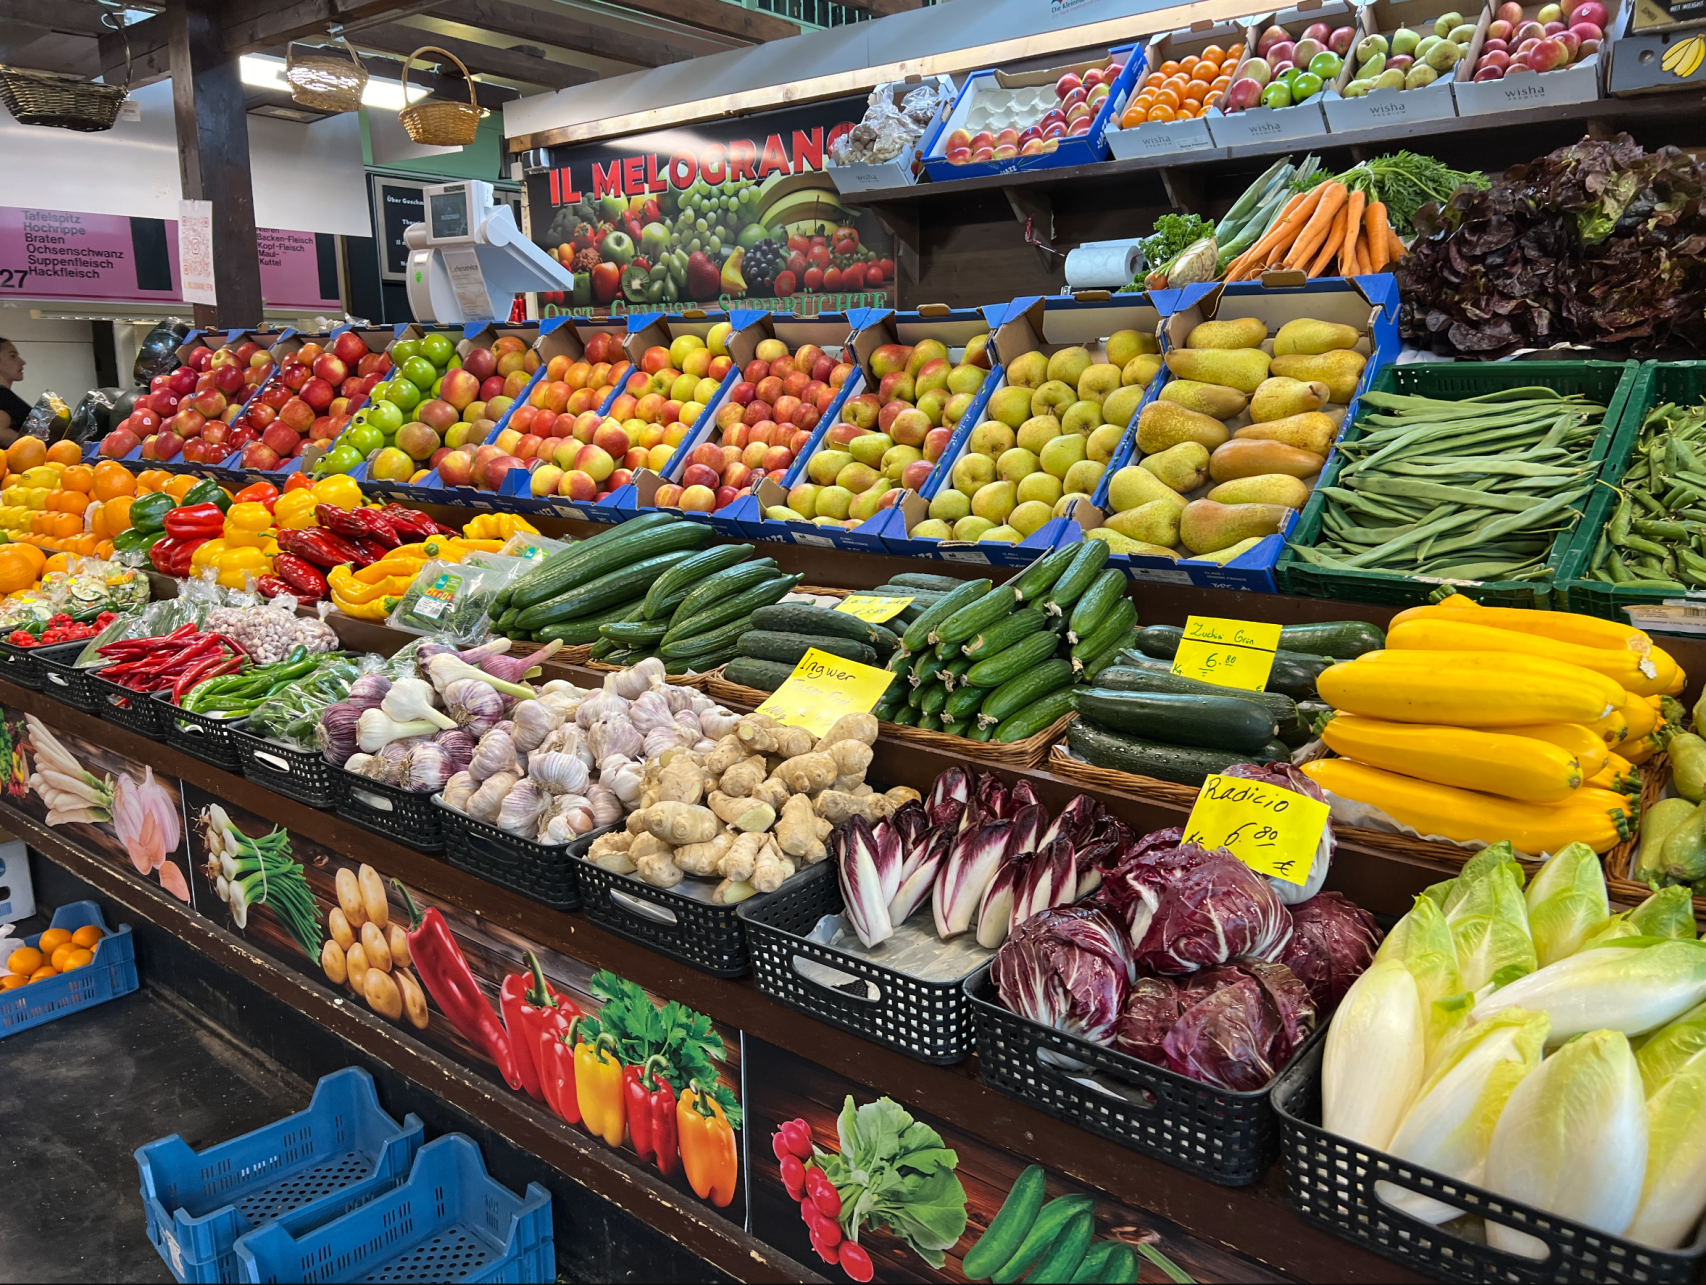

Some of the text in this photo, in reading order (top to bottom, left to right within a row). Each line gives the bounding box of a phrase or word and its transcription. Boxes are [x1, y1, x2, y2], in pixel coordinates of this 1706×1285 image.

[1504, 85, 1545, 98] wisha
[1369, 102, 1406, 114] wisha
[1248, 121, 1281, 134] wisha
[1142, 135, 1171, 145] wisha
[855, 173, 878, 181] wisha
[549, 166, 582, 207] IL
[386, 195, 401, 204] Über
[22, 210, 81, 225] Tafelspitz
[23, 222, 86, 236] Hochrippe
[25, 233, 65, 244] Braten
[257, 233, 314, 244] Backen-Fleisch
[26, 244, 124, 259] Ochsenschwanz
[258, 242, 305, 252] Kopf-Fleisch
[28, 255, 114, 269] Suppenfleisch
[260, 258, 281, 266] Kuttel
[0, 266, 100, 288] 27 Hackfleisch
[800, 653, 856, 680] Ingwer
[789, 678, 824, 697] Faser
[1204, 777, 1289, 813] Radicio
[1272, 860, 1296, 877] €
